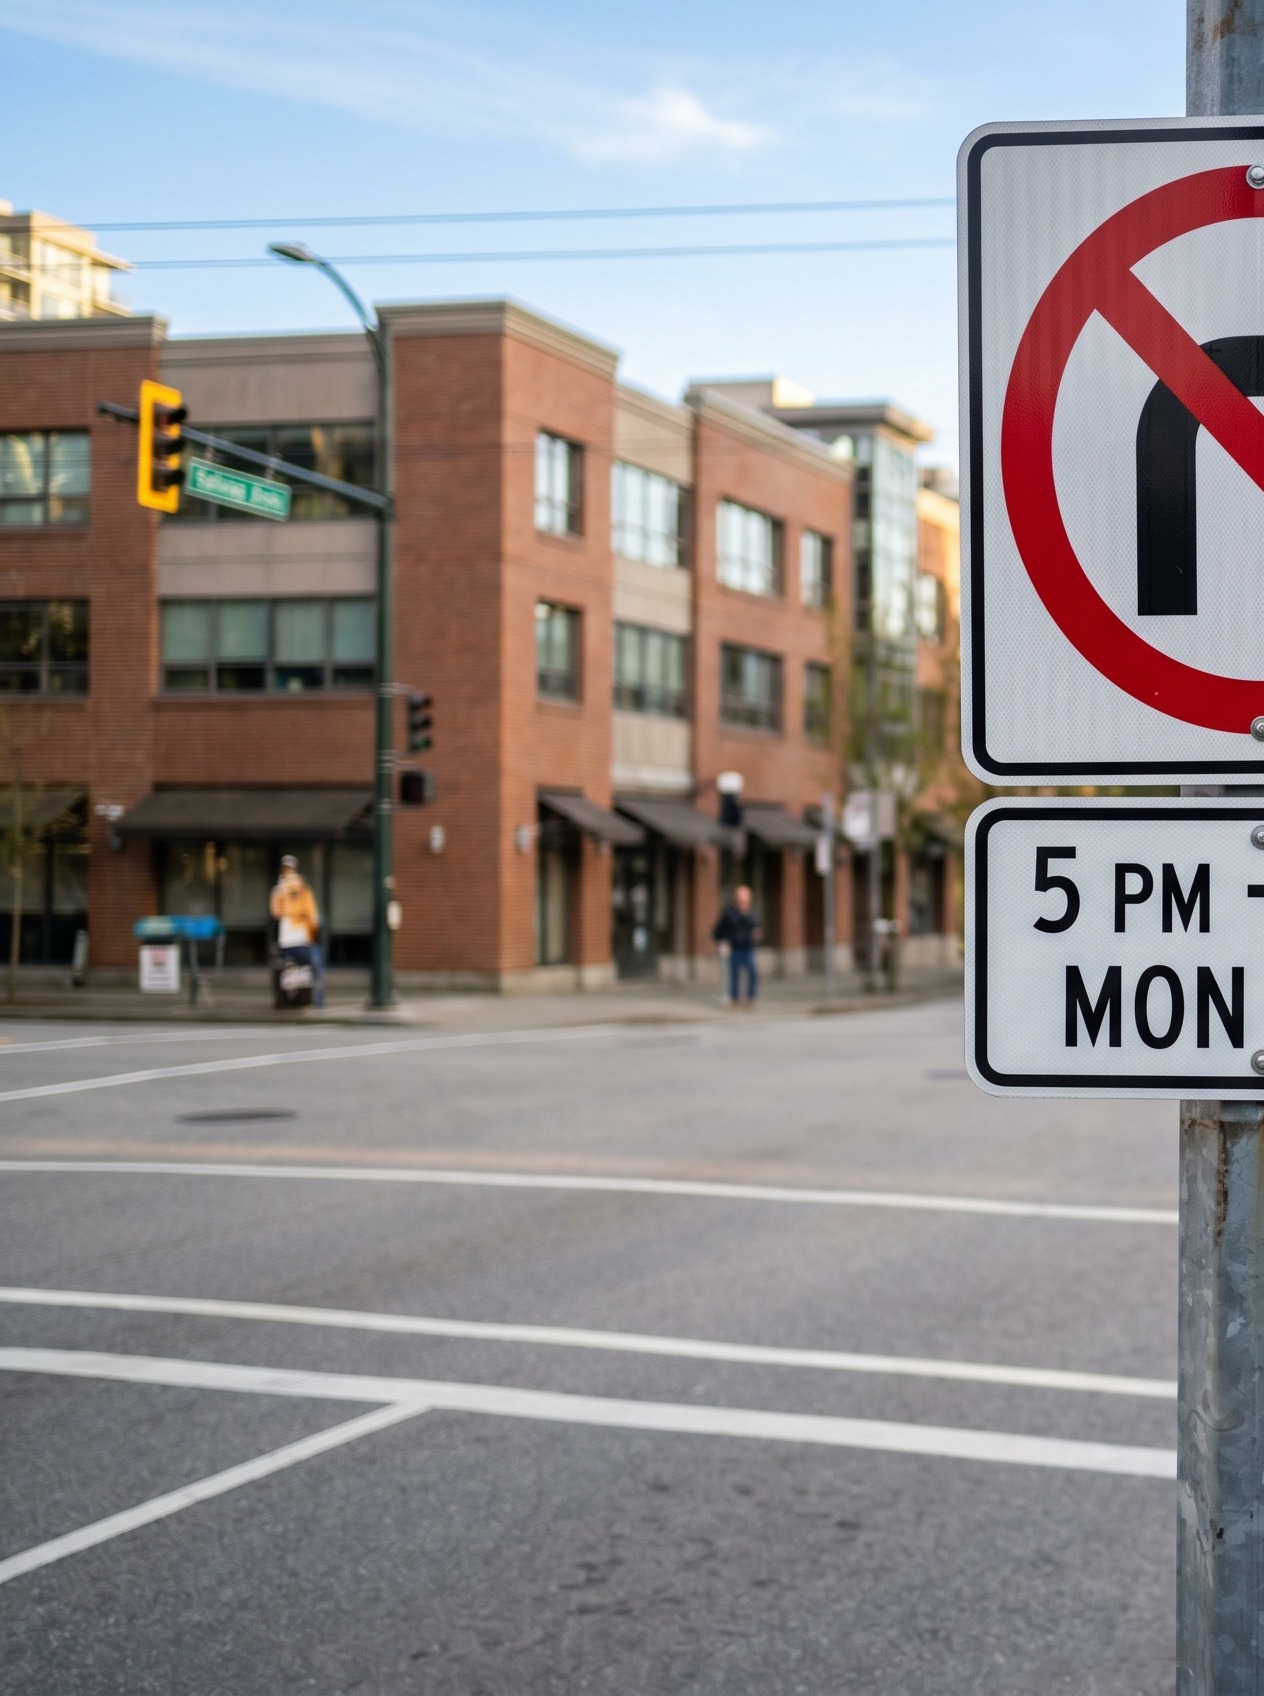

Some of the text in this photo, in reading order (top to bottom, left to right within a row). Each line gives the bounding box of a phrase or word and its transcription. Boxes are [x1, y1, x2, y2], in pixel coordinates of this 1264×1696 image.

[1032, 846, 1081, 934] 5
[1114, 862, 1211, 934] PM
[1065, 965, 1245, 1050] MON
